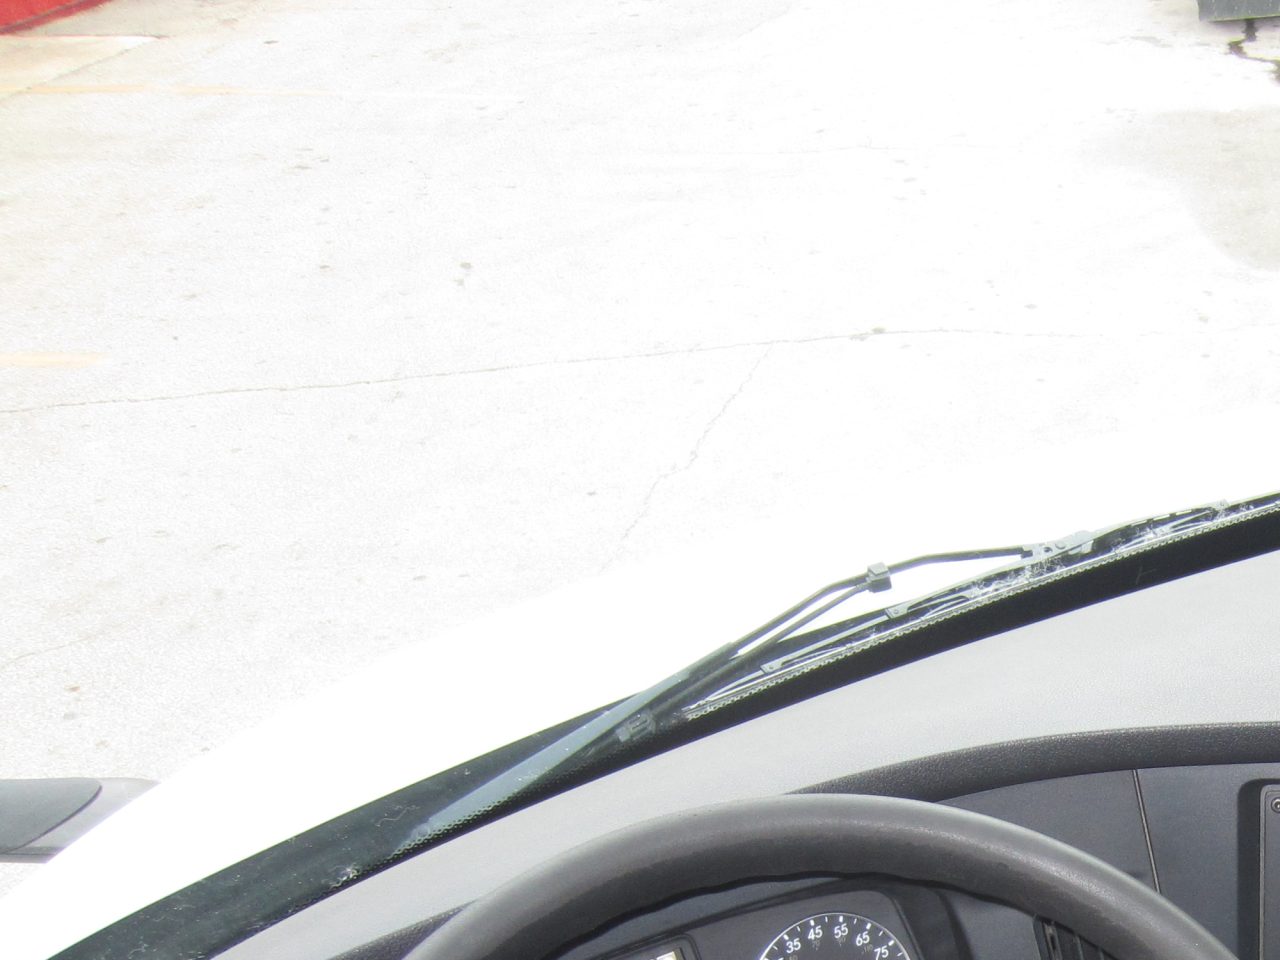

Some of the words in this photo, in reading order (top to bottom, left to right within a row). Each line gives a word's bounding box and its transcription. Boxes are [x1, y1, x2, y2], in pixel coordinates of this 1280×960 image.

[807, 925, 823, 941] 45
[834, 923, 849, 939] 55
[855, 931, 870, 946] 65
[785, 939, 801, 954] 35
[873, 946, 889, 960] 75
